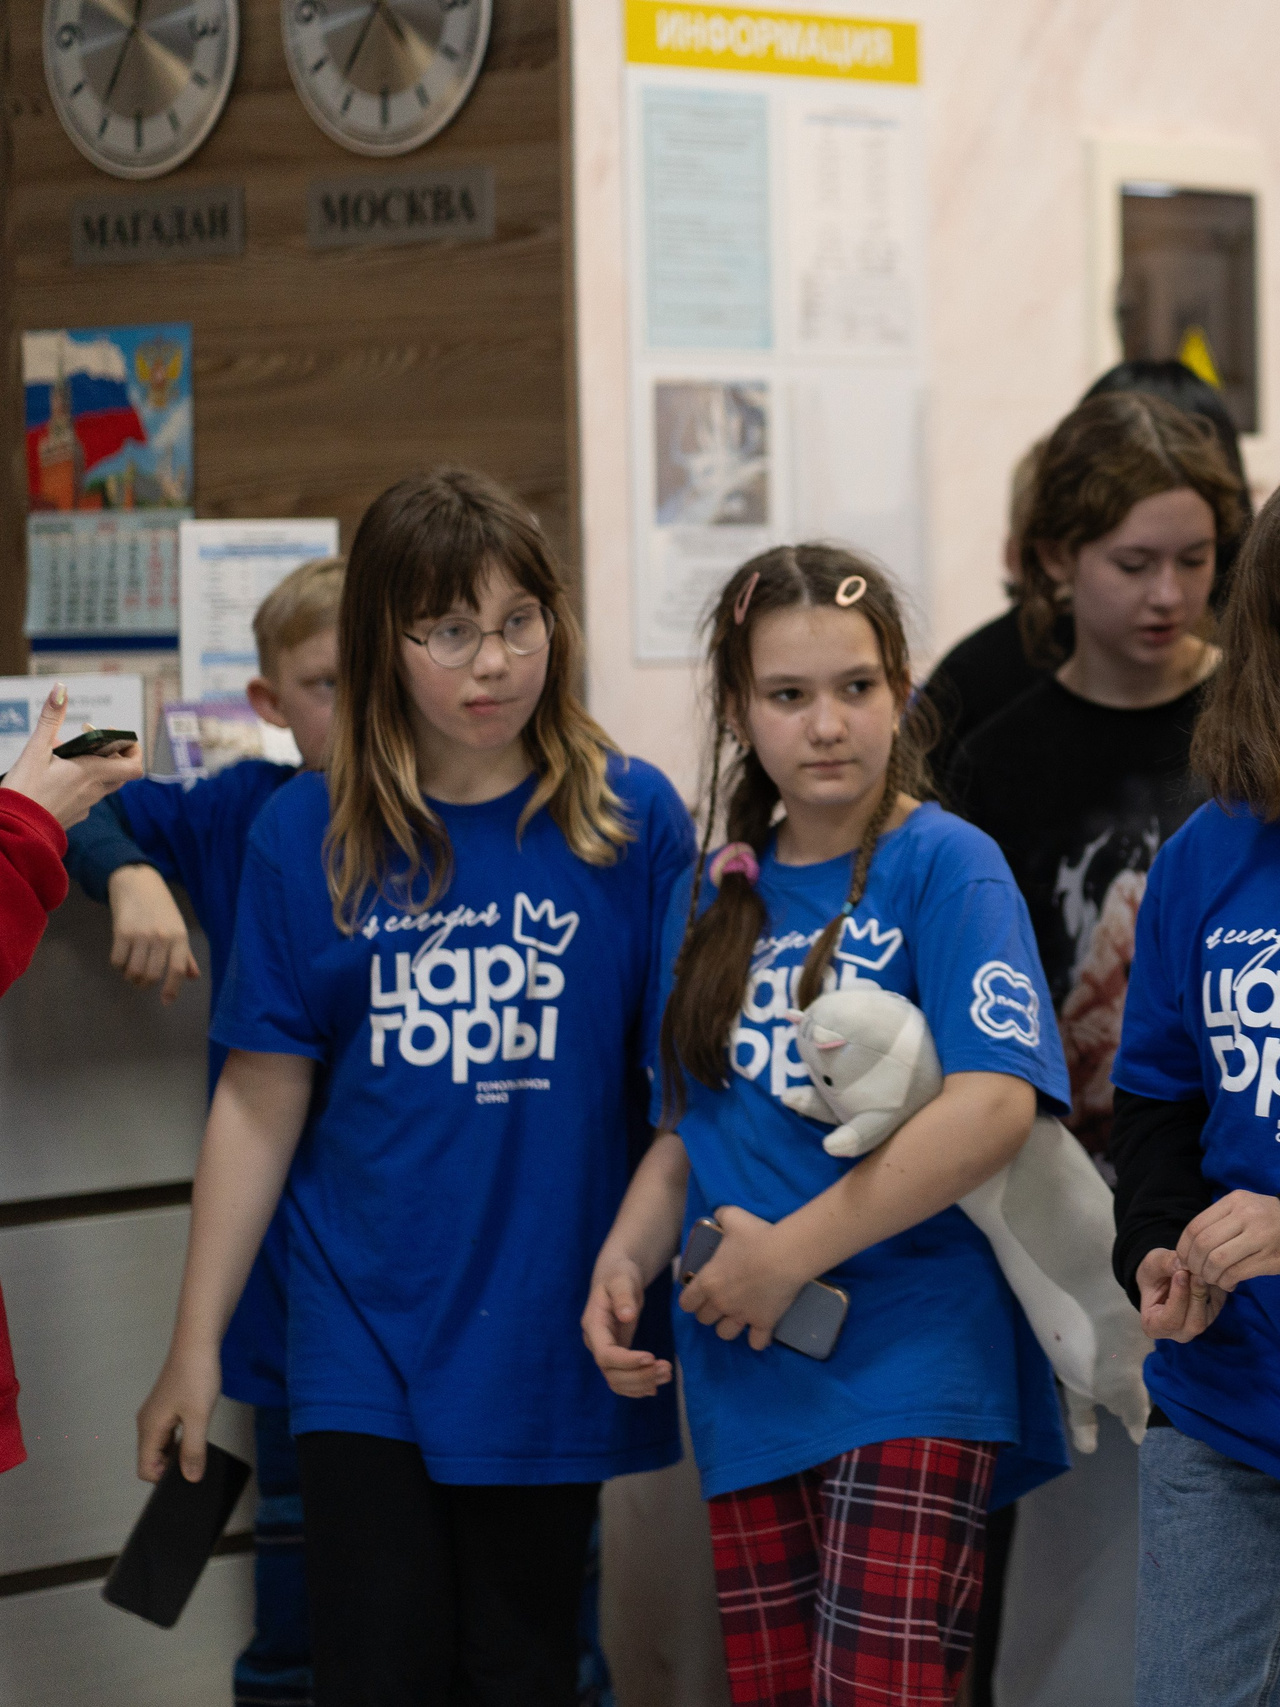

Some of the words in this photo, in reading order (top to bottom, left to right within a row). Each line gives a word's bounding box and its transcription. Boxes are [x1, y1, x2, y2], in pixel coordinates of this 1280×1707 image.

[654, 9, 895, 73] ИНФОРМАЦИЯ
[80, 202, 231, 248] МАГАДАН
[320, 184, 479, 233] МОСКВА
